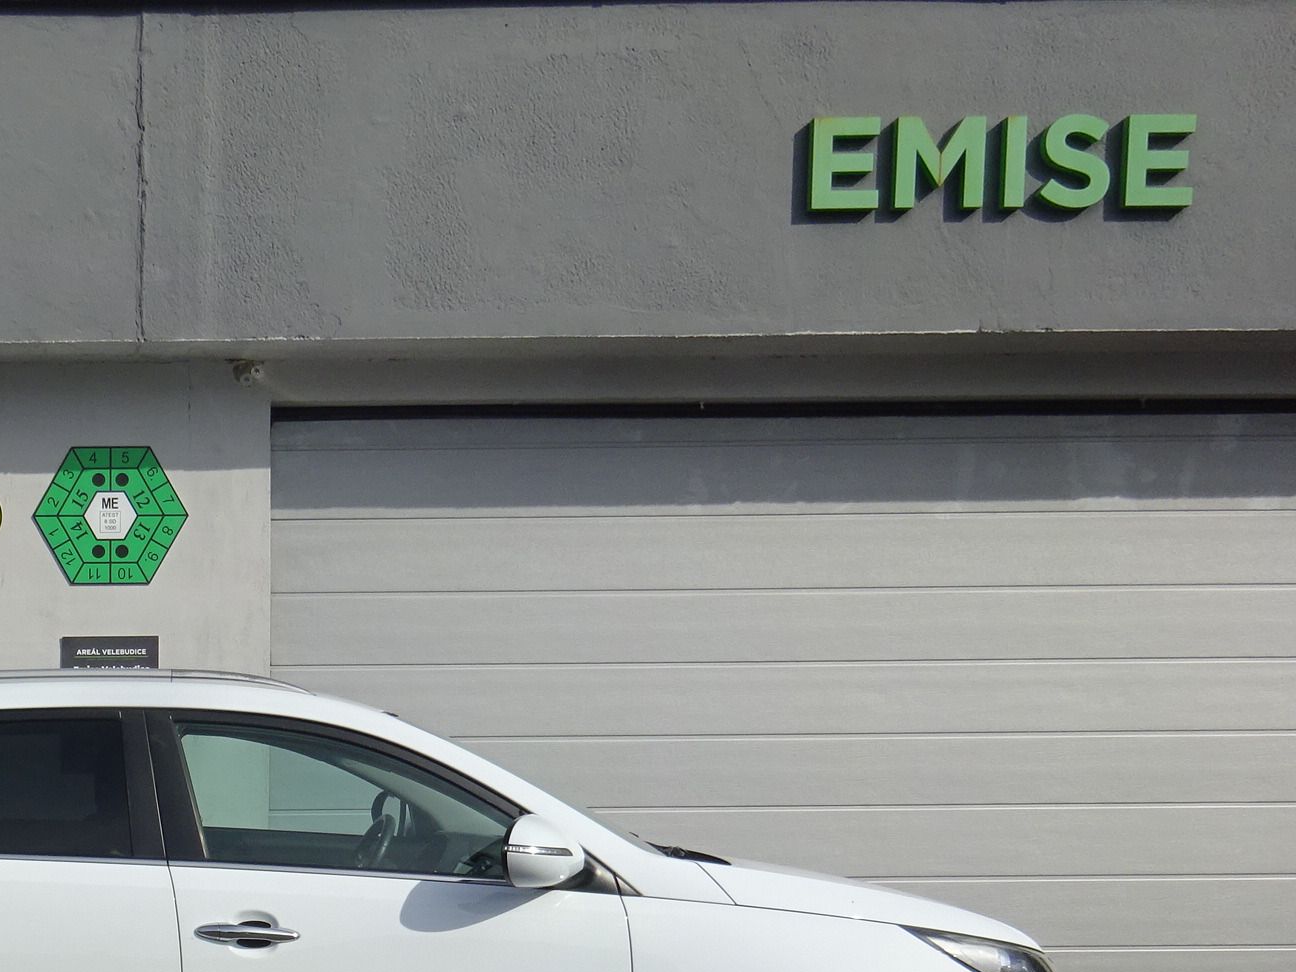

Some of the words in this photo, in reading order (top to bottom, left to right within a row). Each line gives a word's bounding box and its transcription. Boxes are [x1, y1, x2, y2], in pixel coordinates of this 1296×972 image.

[808, 113, 1198, 212] EMISE
[88, 453, 97, 464] 4
[121, 452, 130, 464] 5
[62, 469, 75, 480] 3
[47, 497, 59, 508] 2
[71, 489, 89, 509] 15
[101, 497, 119, 510] ME
[133, 490, 150, 509] 12
[70, 520, 88, 540] 14
[133, 522, 151, 541] 13
[162, 525, 174, 536] 8
[60, 549, 76, 566] 12
[87, 568, 101, 579] 11
[117, 568, 133, 579] 10
[76, 648, 100, 656] AREÁL
